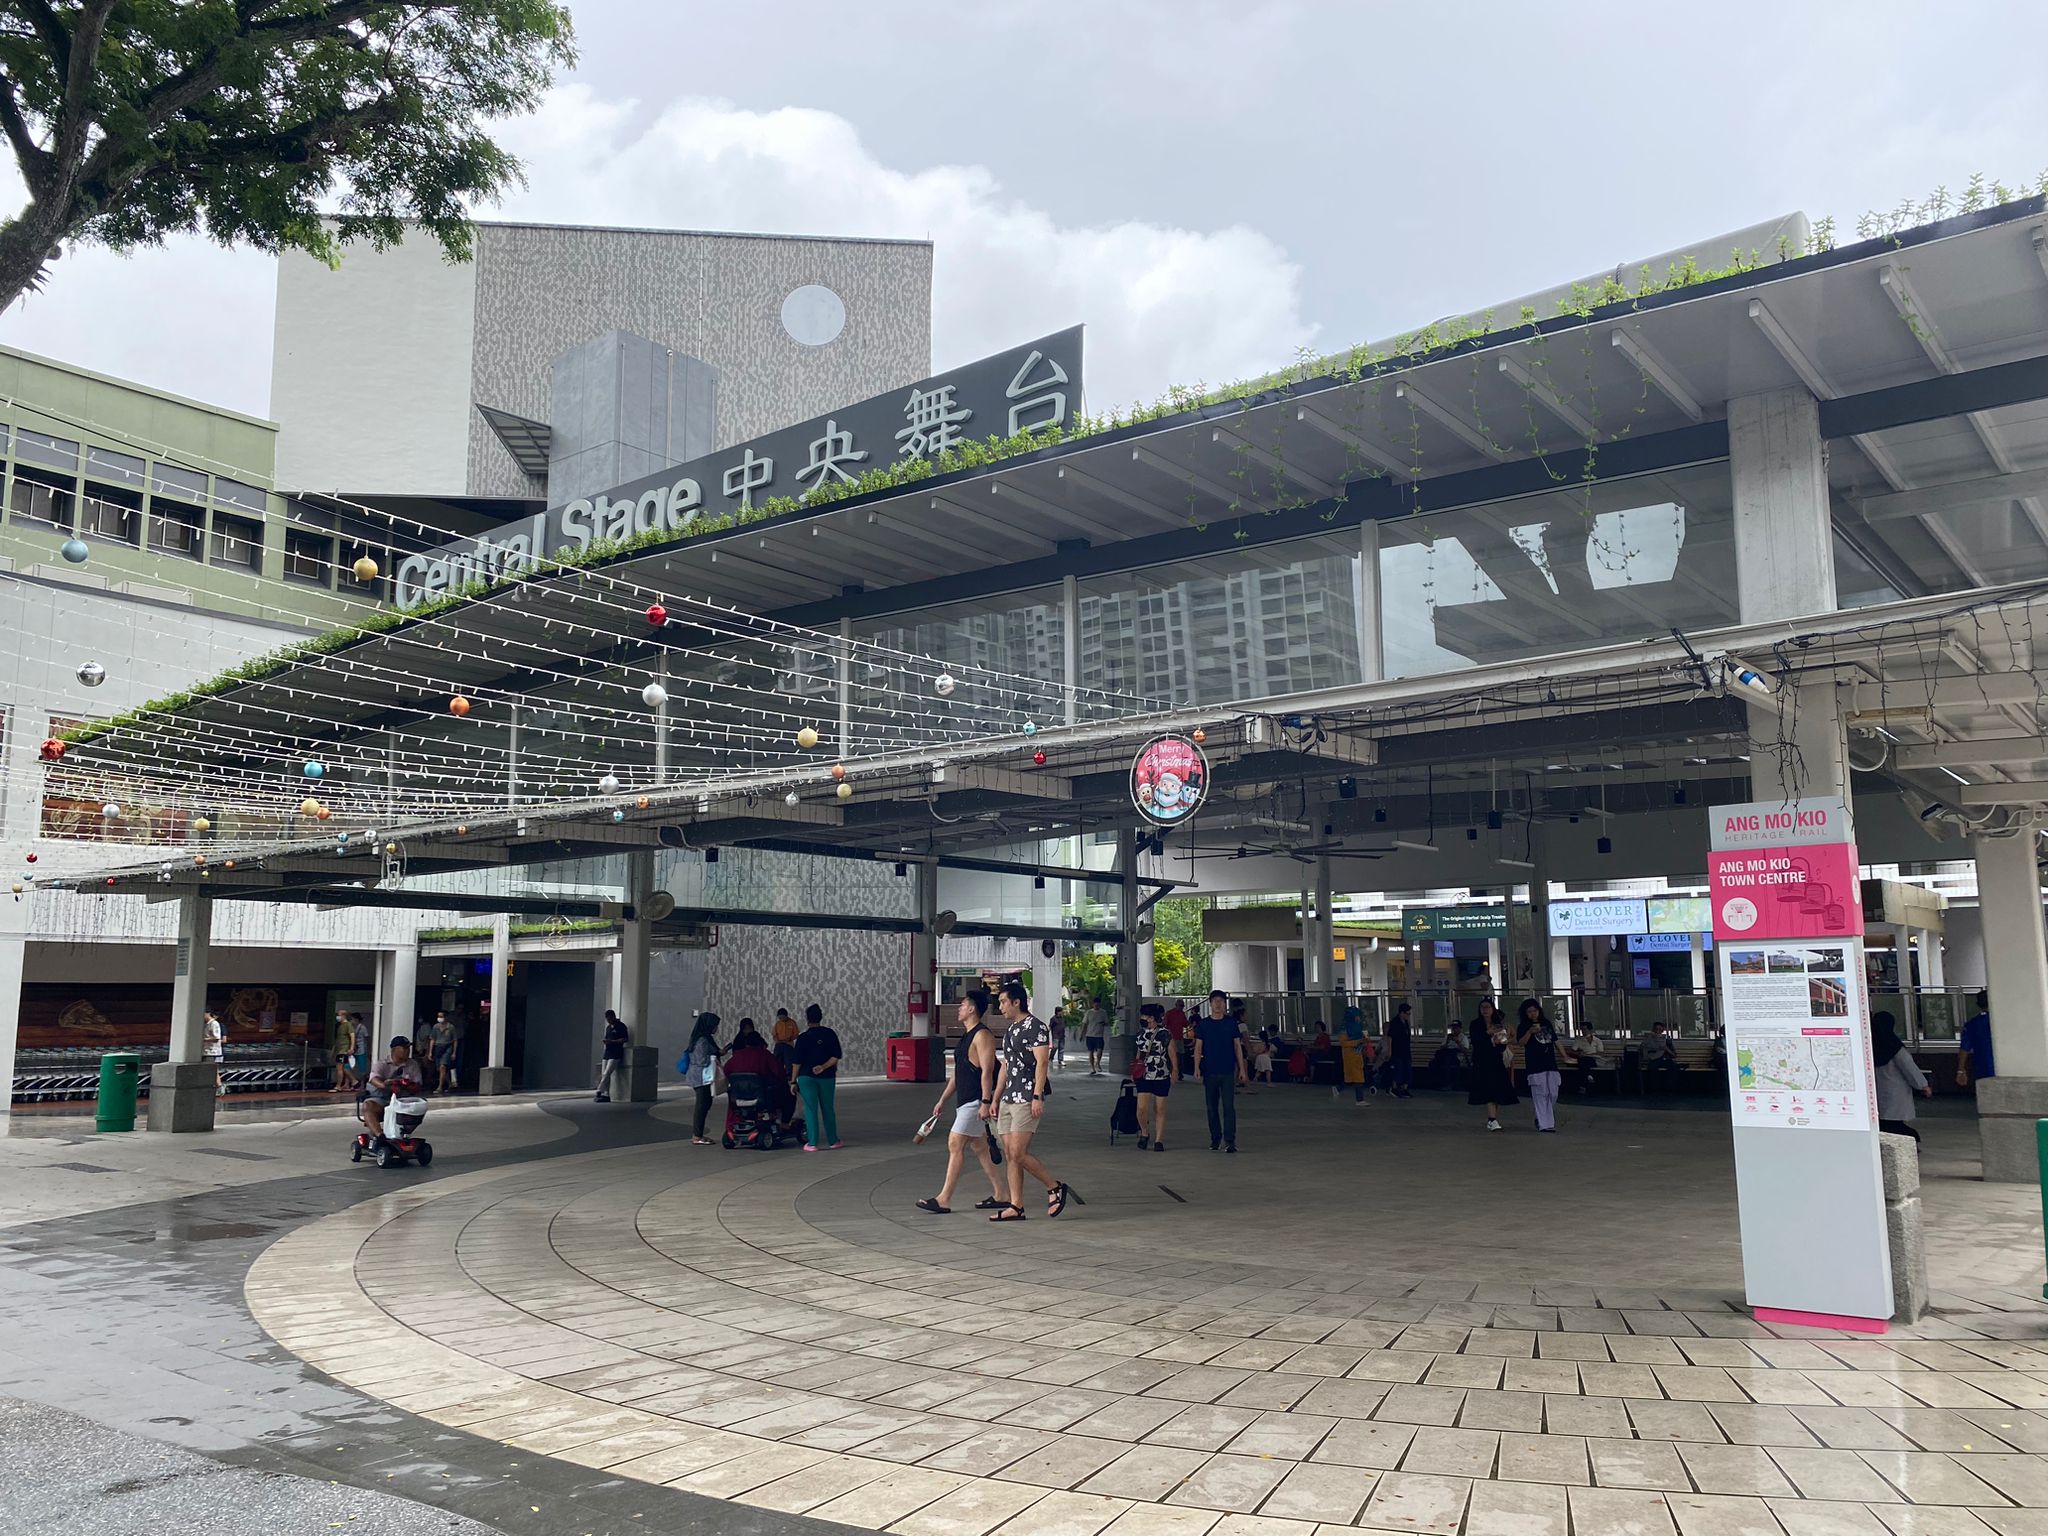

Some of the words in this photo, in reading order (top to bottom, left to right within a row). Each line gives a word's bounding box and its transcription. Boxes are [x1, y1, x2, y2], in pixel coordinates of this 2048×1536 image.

[395, 513, 548, 611] Central
[558, 477, 702, 556] Stage
[722, 350, 1069, 517] 中央舞台
[1159, 744, 1185, 755] Merry
[1144, 753, 1194, 767] Christmas
[1725, 815, 1759, 832] ANG
[1764, 812, 1792, 829] MO
[1797, 810, 1827, 827] KIO
[1724, 831, 1785, 842] HERITAGE
[1719, 861, 1744, 873] ANG
[1747, 859, 1767, 872] MO
[1769, 857, 1791, 870] KIO
[1719, 874, 1755, 887] TOWN
[1758, 871, 1806, 885] CENTRE
[1574, 905, 1632, 917] CLOVER
[1574, 918, 1600, 926] Dental
[1602, 917, 1633, 928] Surgery
